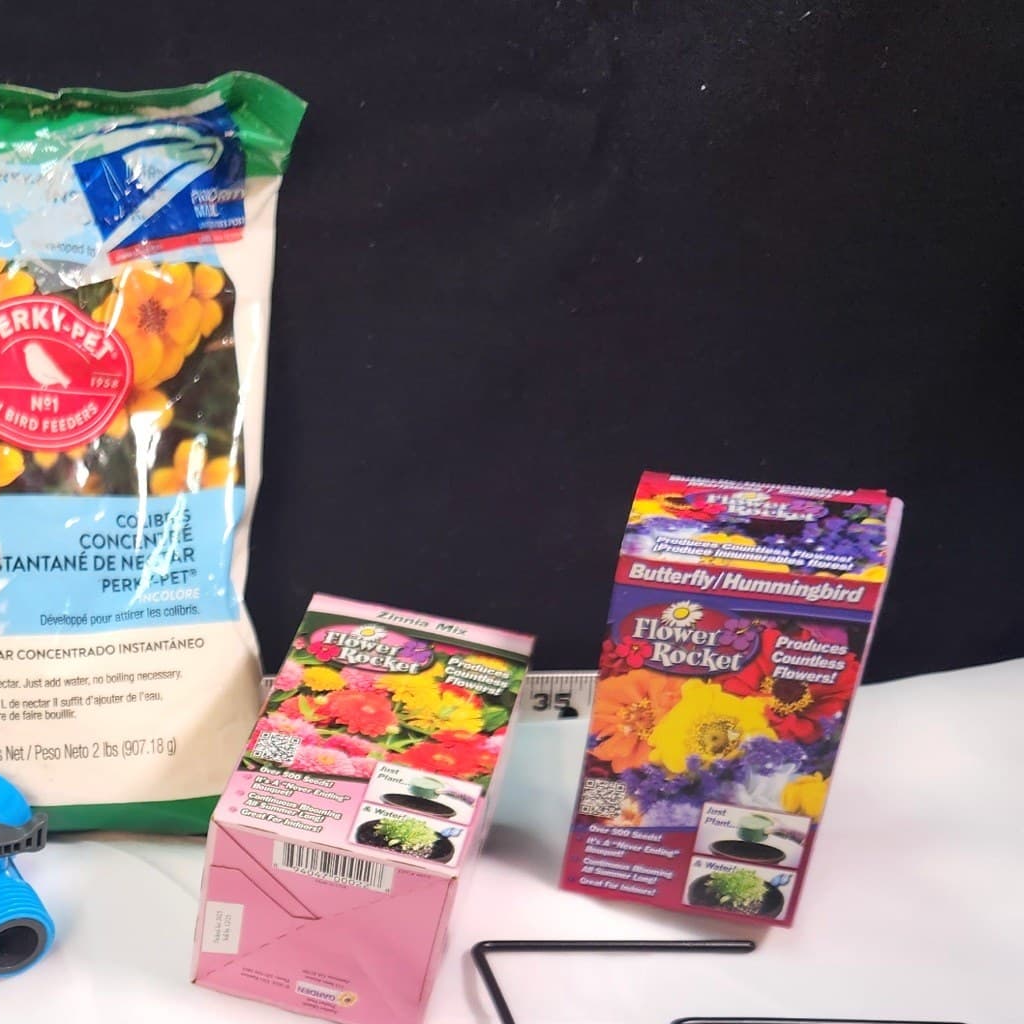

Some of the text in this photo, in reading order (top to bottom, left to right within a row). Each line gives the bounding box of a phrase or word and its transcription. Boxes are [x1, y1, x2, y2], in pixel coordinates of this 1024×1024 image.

[90, 376, 120, 389] 1958
[4, 408, 39, 432] BIRD
[41, 401, 99, 433] FEEDERS
[116, 509, 192, 529] COIBS
[656, 536, 721, 549] Produces
[721, 542, 791, 557] Countless
[93, 555, 117, 572] DE
[121, 547, 195, 571] NEAR
[40, 605, 201, 628] Développé pour attirer les colibris.
[376, 610, 468, 637] Zinnia Mix
[324, 631, 401, 656] Flower
[631, 616, 720, 650] Flower
[17, 644, 116, 660] CONCENTRADO
[119, 637, 205, 655] INSTANTÁNEO
[774, 635, 849, 656] Produces
[339, 648, 420, 675] Rocket
[447, 655, 511, 679] Produces
[650, 641, 743, 673] Rocket
[771, 650, 846, 672] Countless
[23, 678, 42, 688] Just
[44, 677, 61, 688] add
[93, 675, 104, 685] no
[106, 672, 134, 685] boiling
[444, 665, 510, 688] Countless
[444, 675, 503, 696] Flowers!
[772, 665, 838, 685] Flowers!
[9, 698, 20, 709] de
[22, 698, 50, 708] nectar
[126, 692, 137, 702] de
[532, 693, 572, 711] 35
[9, 710, 20, 720] de
[23, 710, 42, 720] faire
[6, 745, 24, 761] Net
[34, 744, 61, 761] Peso
[64, 743, 89, 760] Neto
[92, 742, 100, 758] 2
[103, 741, 118, 758] lbs
[259, 766, 281, 776] Over
[379, 765, 400, 775] Just
[240, 808, 267, 820] Great
[267, 813, 284, 823] For
[245, 798, 260, 808] All
[260, 801, 297, 816] Summer
[248, 791, 343, 820] Continuous Blooming
[706, 806, 727, 816] Just
